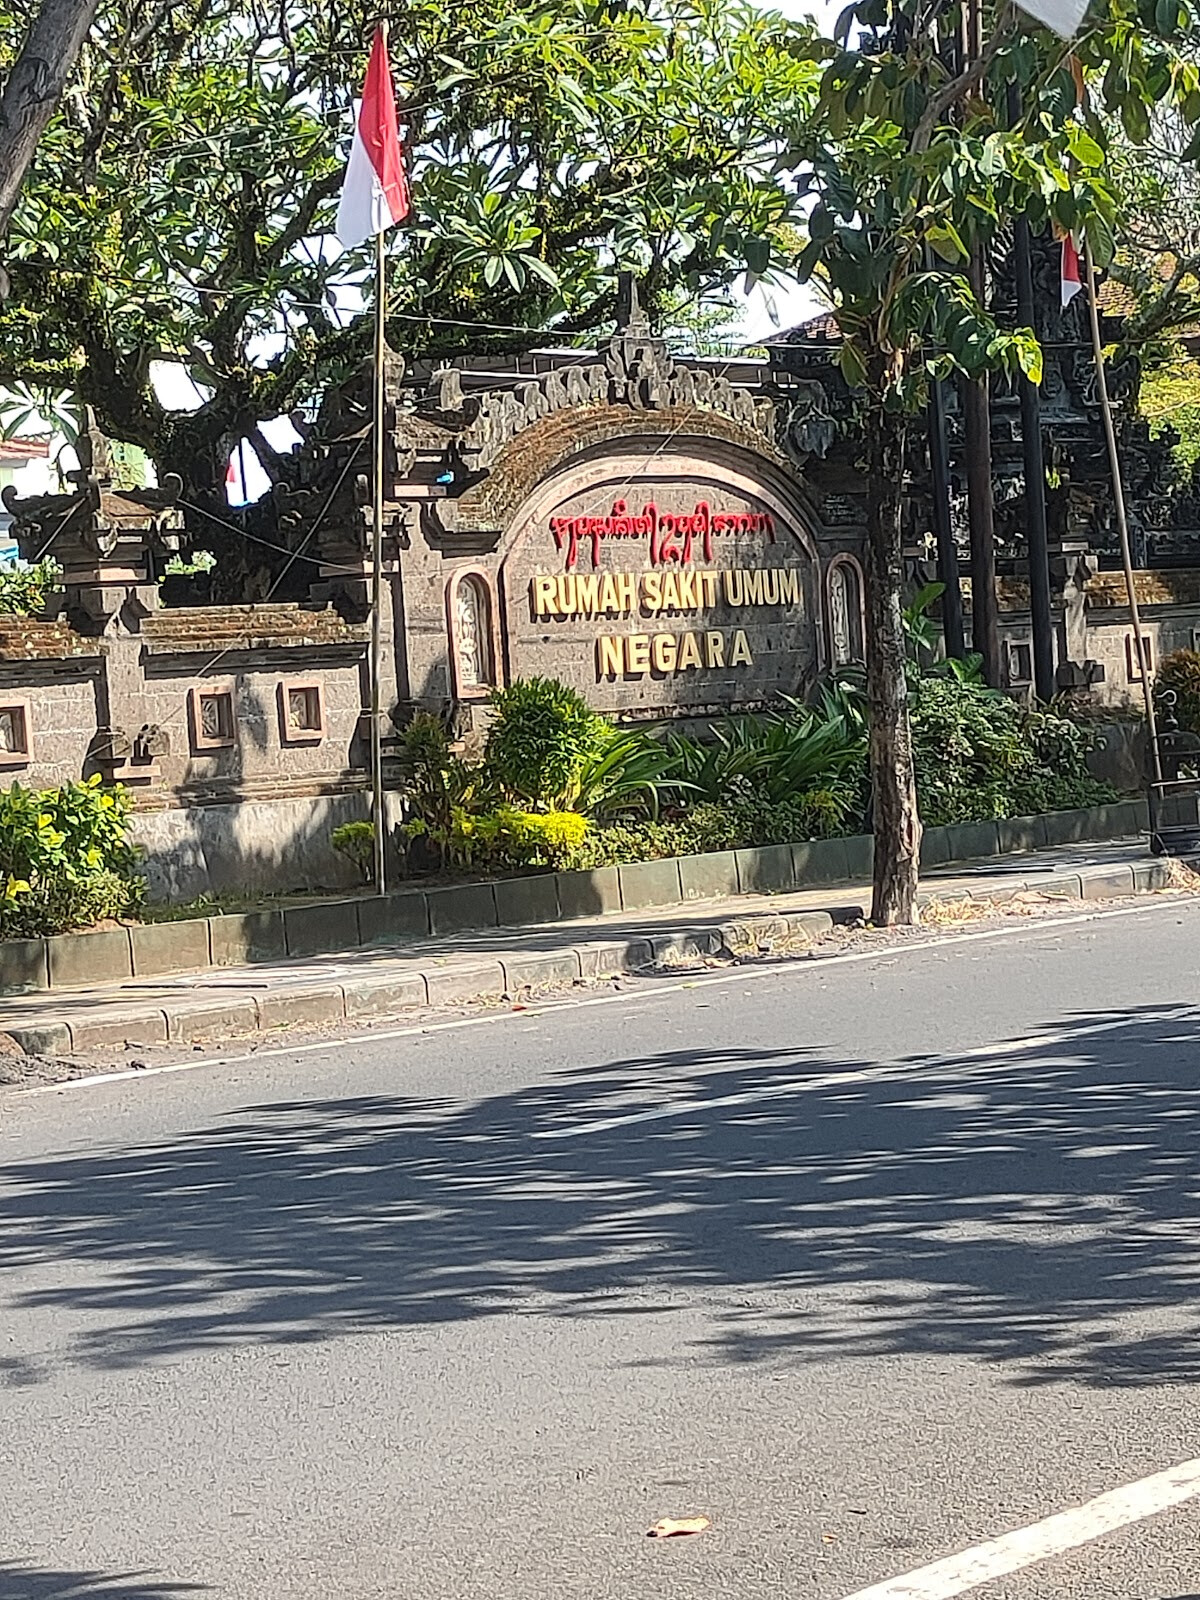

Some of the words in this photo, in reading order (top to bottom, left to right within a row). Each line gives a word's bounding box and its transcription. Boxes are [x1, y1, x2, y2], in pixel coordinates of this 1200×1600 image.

[533, 572, 637, 616] RUMAH
[642, 570, 718, 611] SAKIT
[723, 568, 801, 608] UMUM
[598, 629, 754, 676] NEGARA
